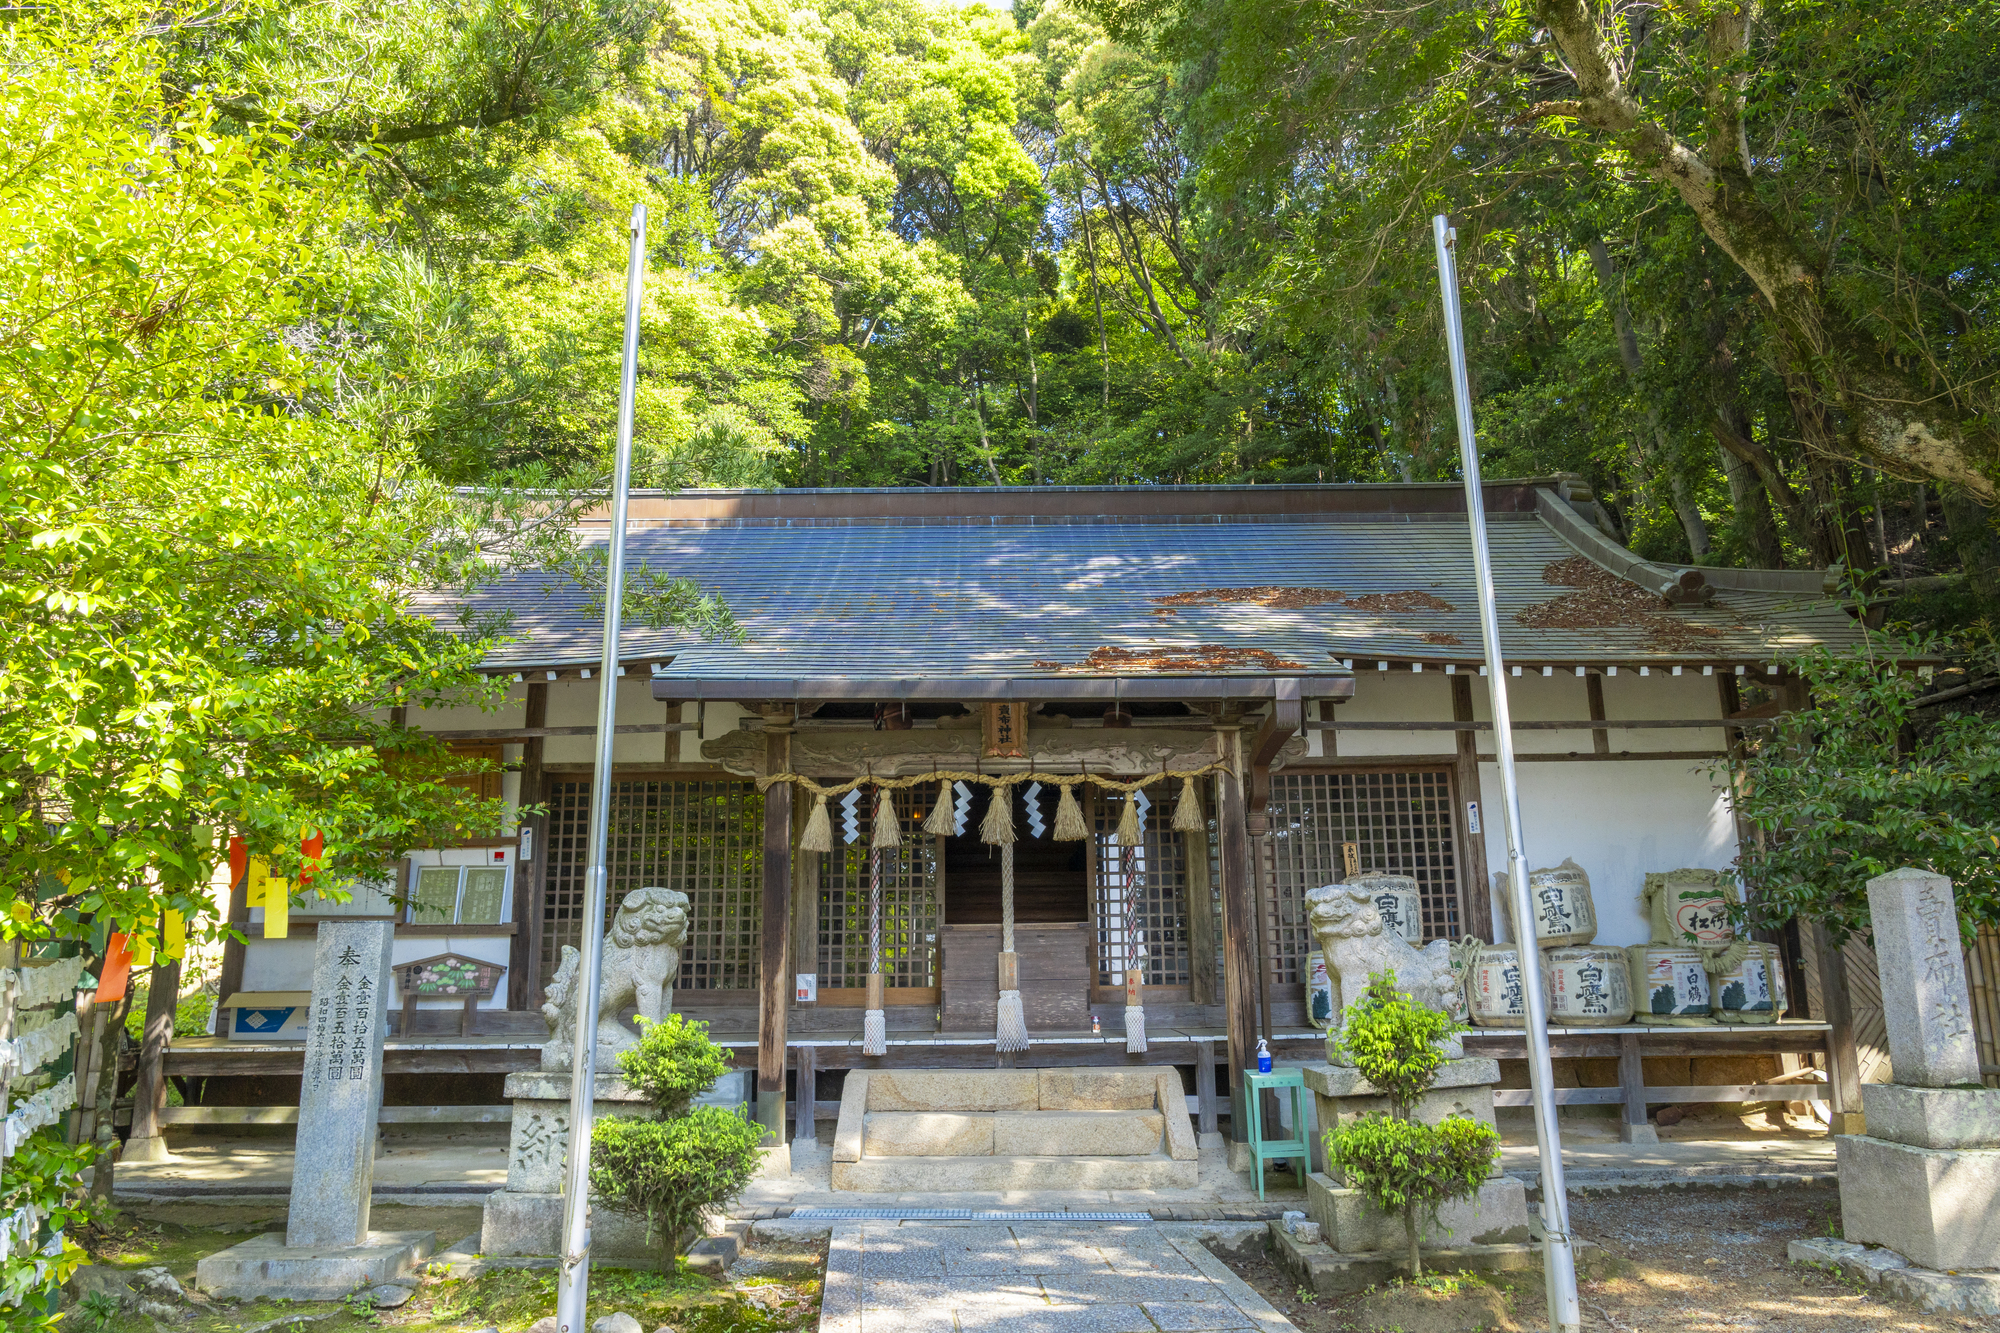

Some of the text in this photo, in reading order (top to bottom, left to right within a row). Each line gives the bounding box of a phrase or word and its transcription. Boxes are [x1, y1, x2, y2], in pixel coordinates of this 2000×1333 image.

[1538, 886, 1573, 934] 白鷹
[1688, 911, 1730, 931] 松竹
[337, 945, 361, 970] 奉
[1575, 963, 1610, 1014] 白鷹
[1686, 968, 1702, 1003] 白鶴
